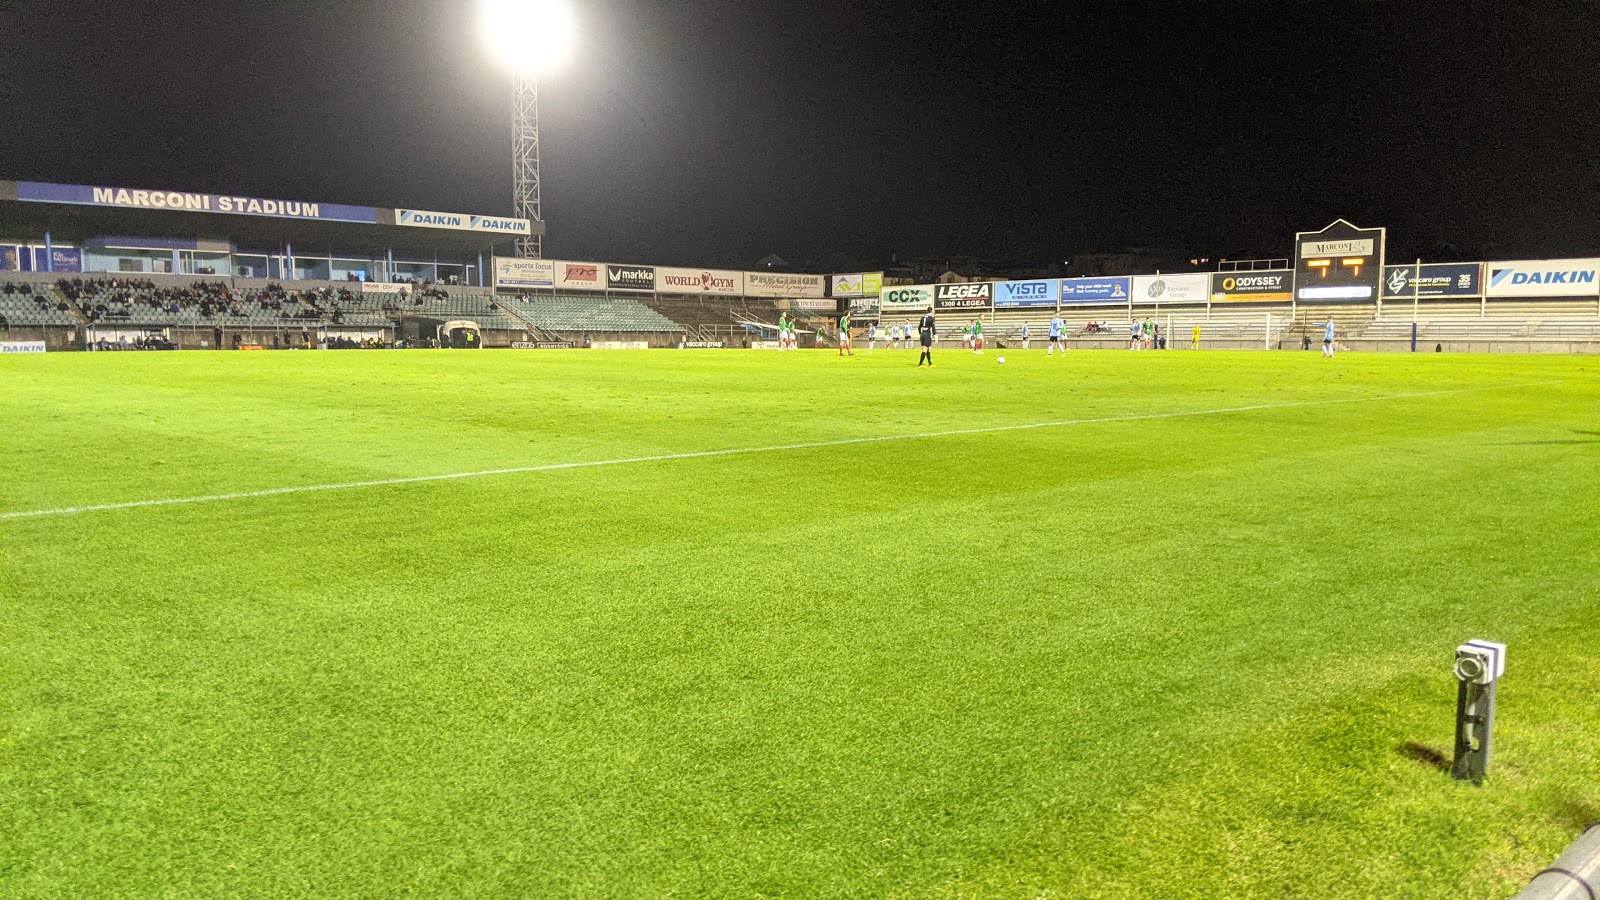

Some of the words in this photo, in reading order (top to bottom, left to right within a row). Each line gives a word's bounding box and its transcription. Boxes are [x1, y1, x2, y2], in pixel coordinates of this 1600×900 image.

[93, 187, 210, 210] MARCONI
[218, 196, 319, 217] STADIUM
[413, 214, 461, 226] DAIKIN
[482, 219, 526, 231] DAIKIN
[1316, 243, 1352, 253] MARCONI
[514, 263, 534, 271] sports
[535, 262, 552, 270] focus
[563, 267, 600, 283] pro
[622, 269, 654, 280] markka
[749, 274, 819, 286] PRECISION
[1459, 274, 1471, 283] 35
[1511, 271, 1595, 284] DAIKIN
[665, 275, 701, 287] WORLD
[712, 279, 735, 288] GYM
[785, 283, 808, 292] Group
[1236, 276, 1282, 287] ODYSSEY
[938, 284, 989, 299] LEGEA
